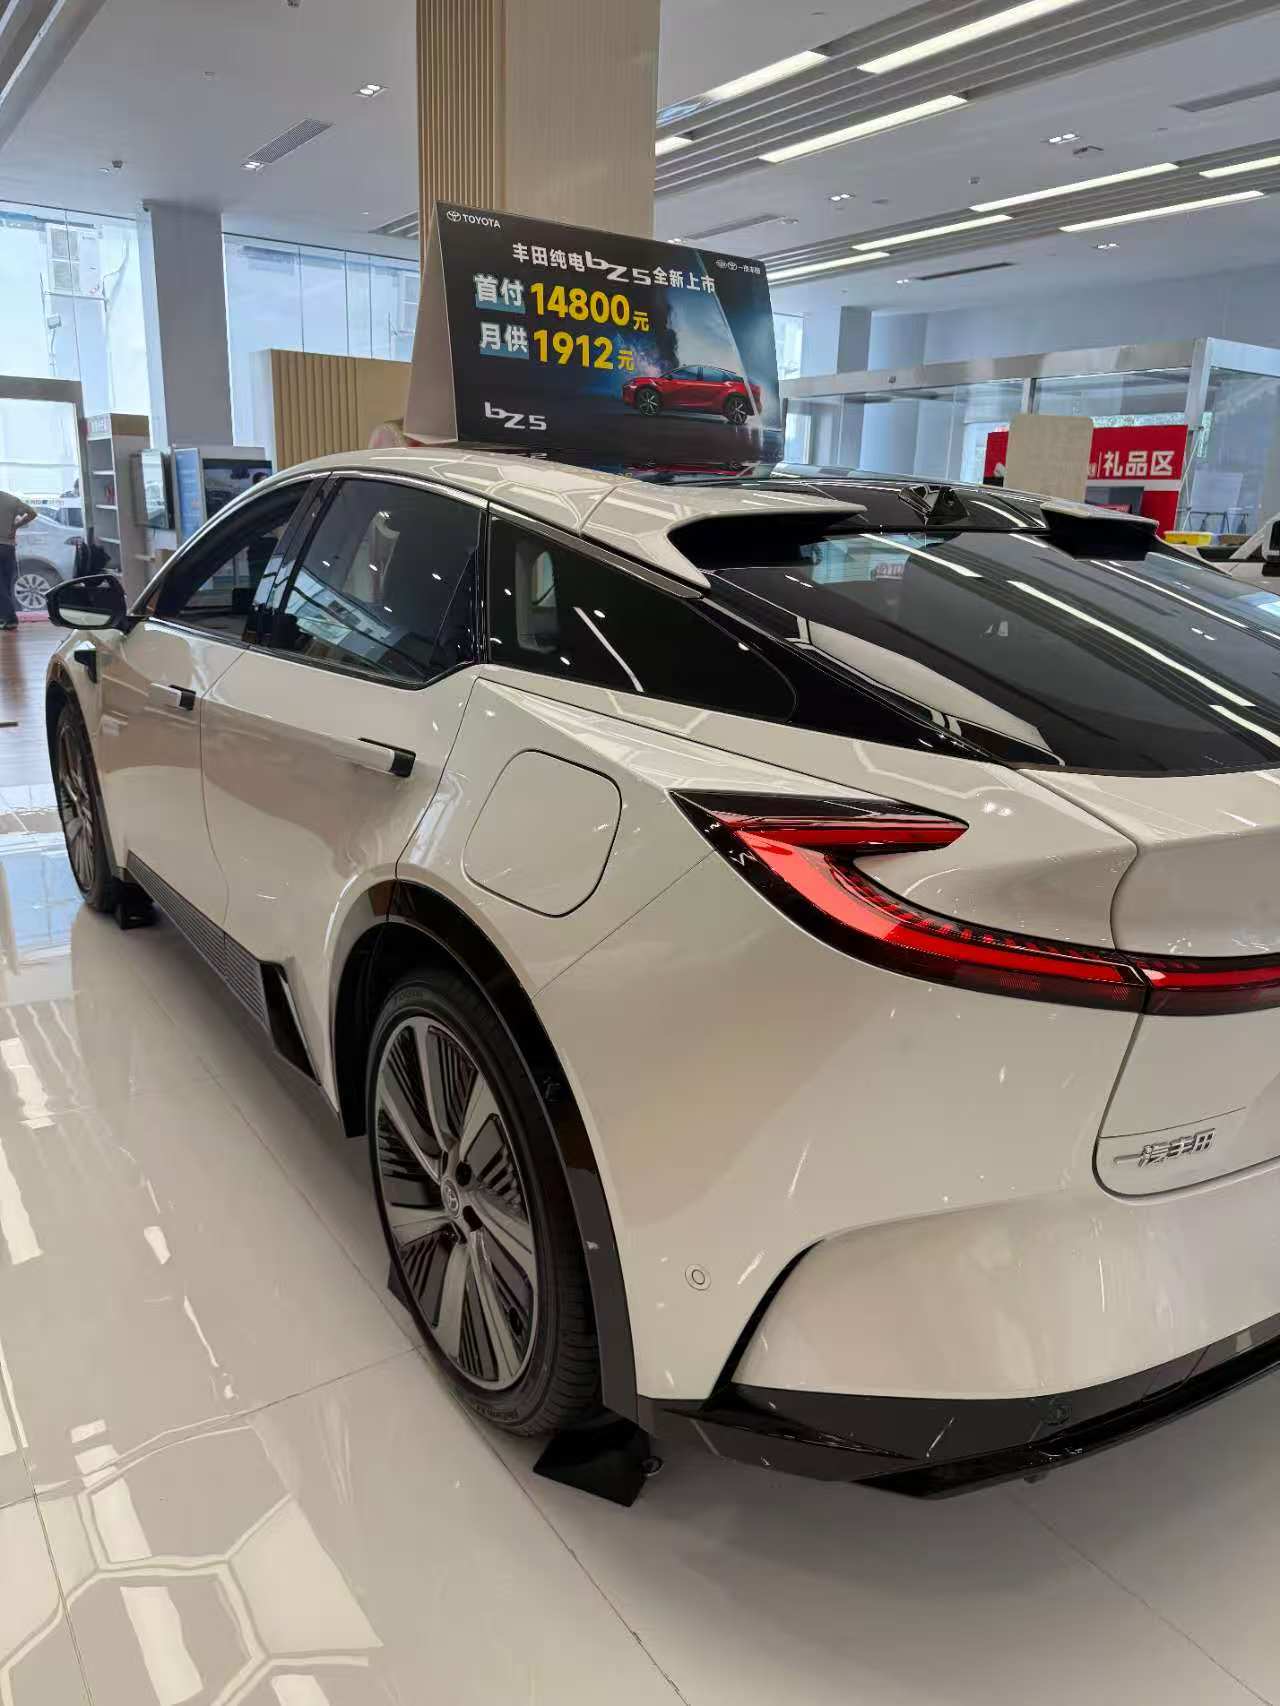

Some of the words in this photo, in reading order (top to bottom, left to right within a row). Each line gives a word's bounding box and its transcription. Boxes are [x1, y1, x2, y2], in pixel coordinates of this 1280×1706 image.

[462, 213, 501, 229] TOYOTA
[1103, 450, 1175, 477] 礼品区
